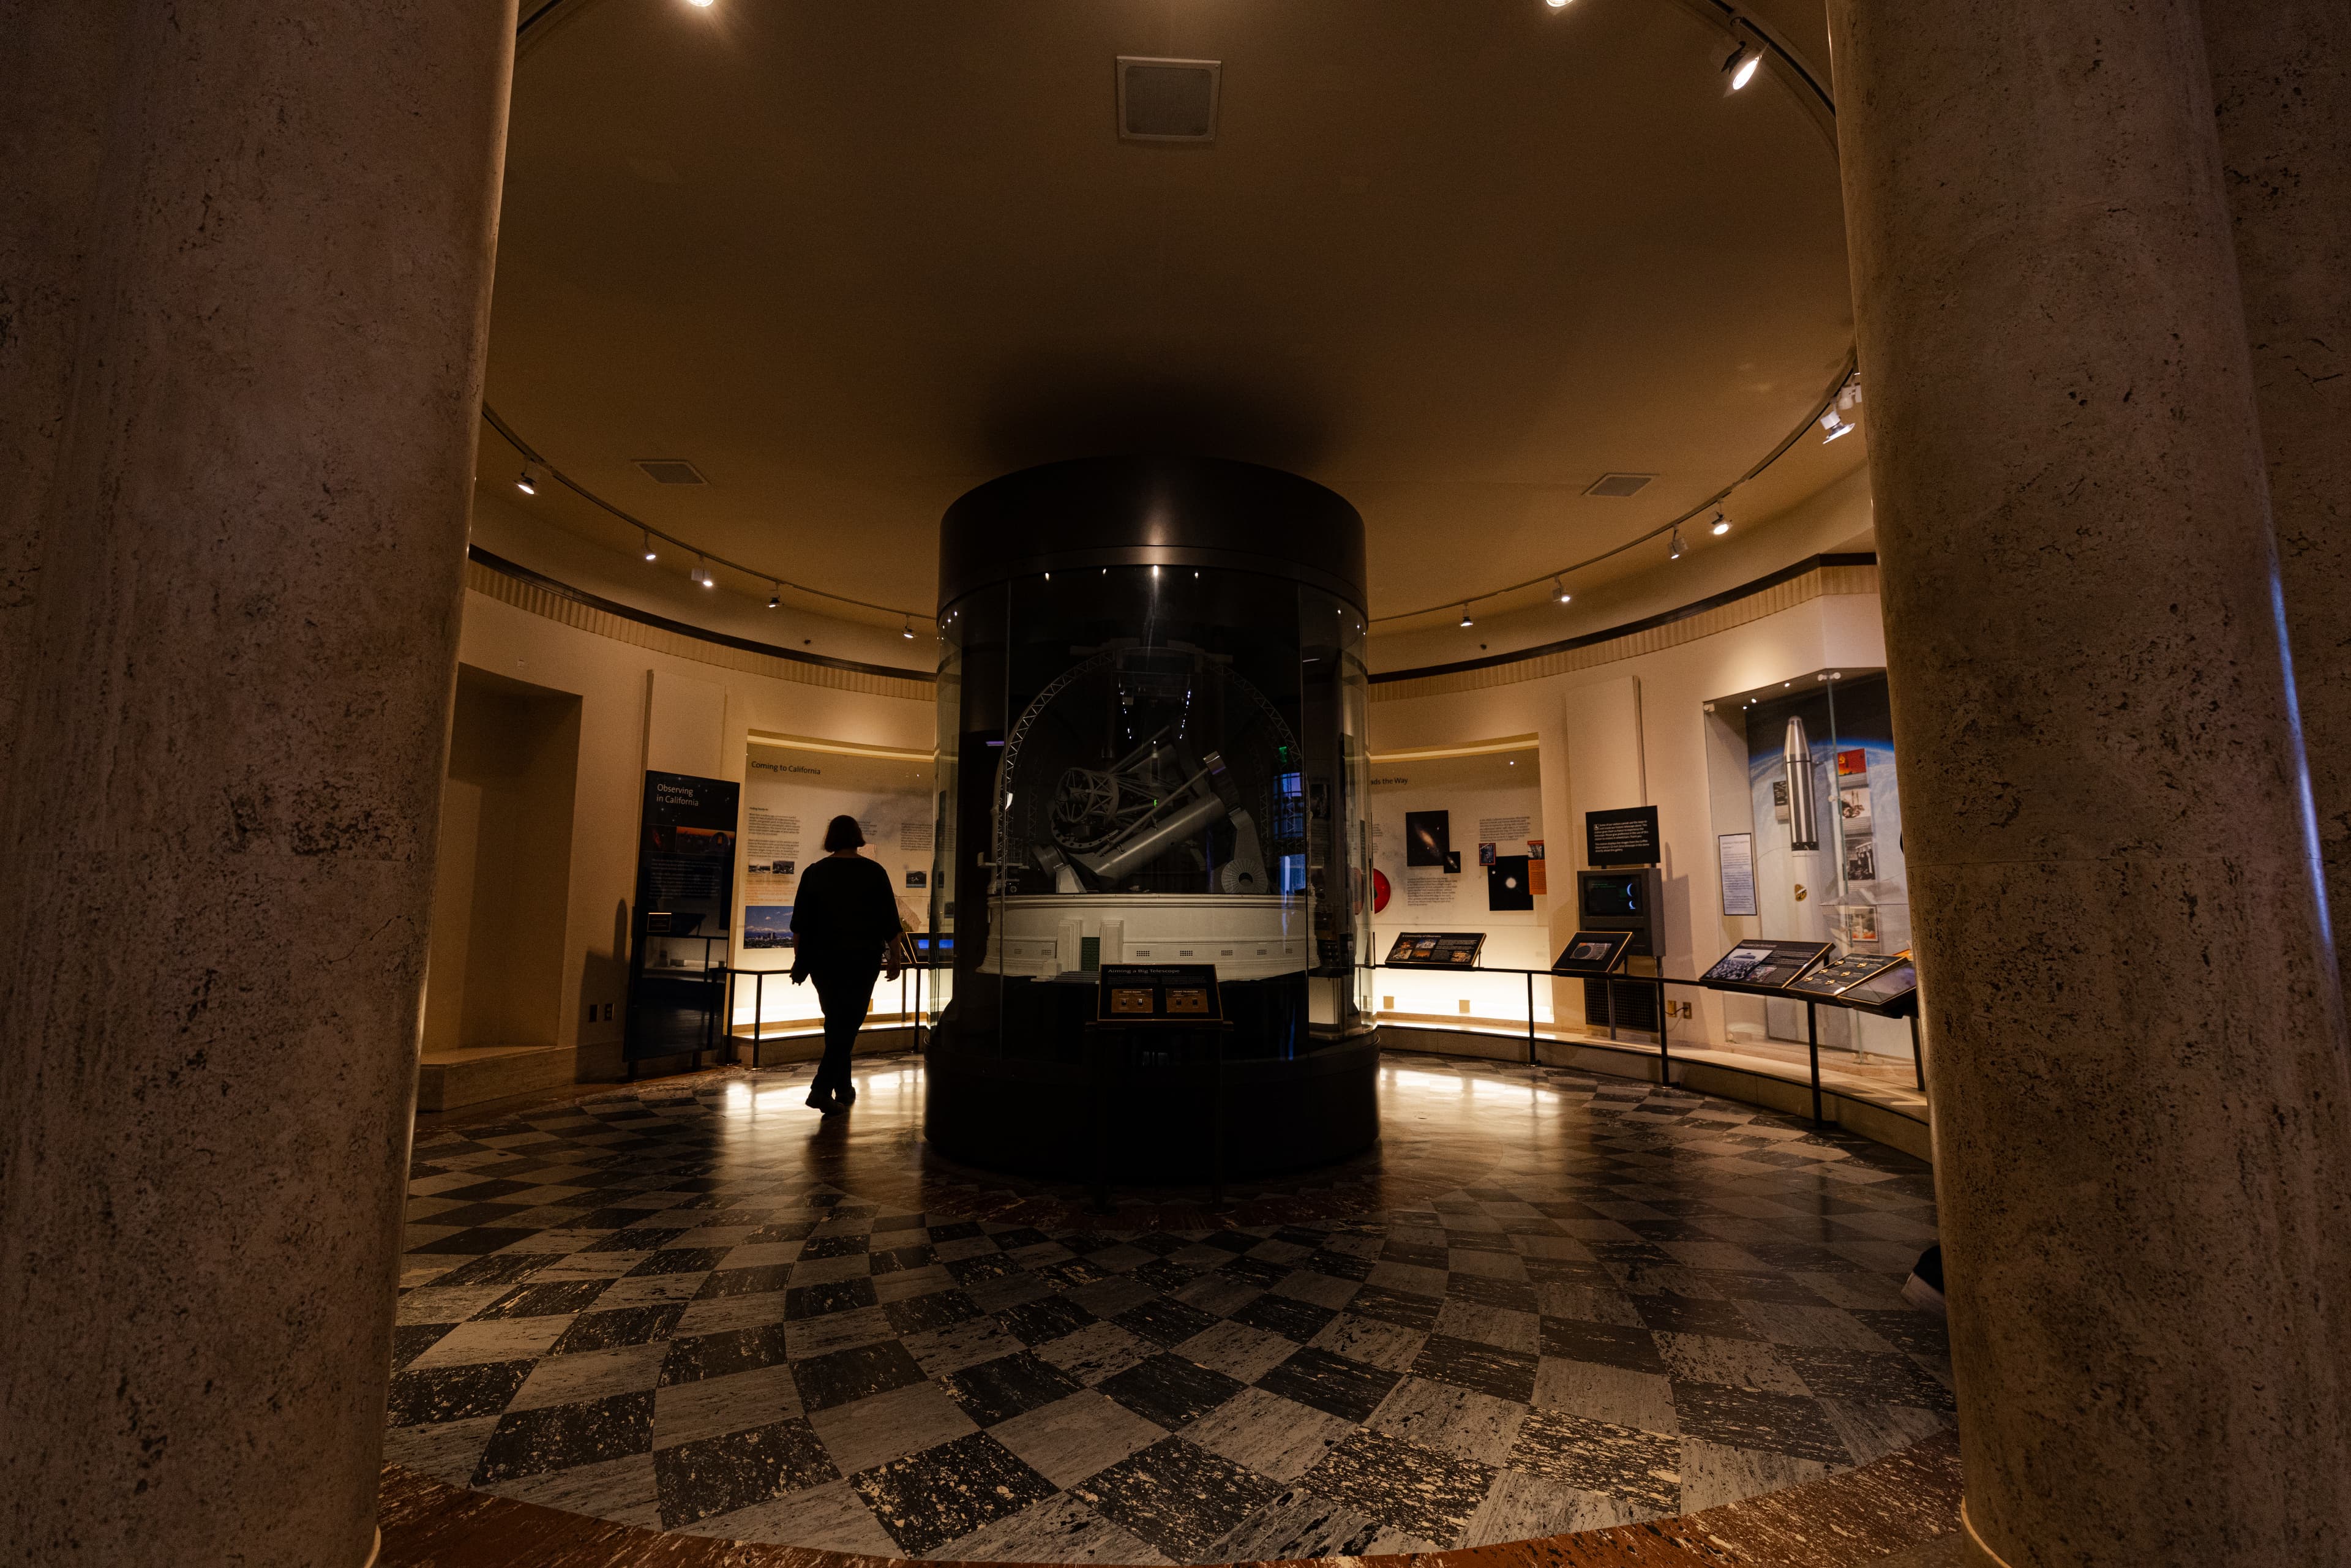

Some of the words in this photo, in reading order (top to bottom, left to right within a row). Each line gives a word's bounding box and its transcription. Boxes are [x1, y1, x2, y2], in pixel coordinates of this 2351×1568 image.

[751, 761, 778, 773] Coming
[789, 765, 821, 775] California
[657, 783, 694, 798] Observing
[665, 795, 699, 806] California
